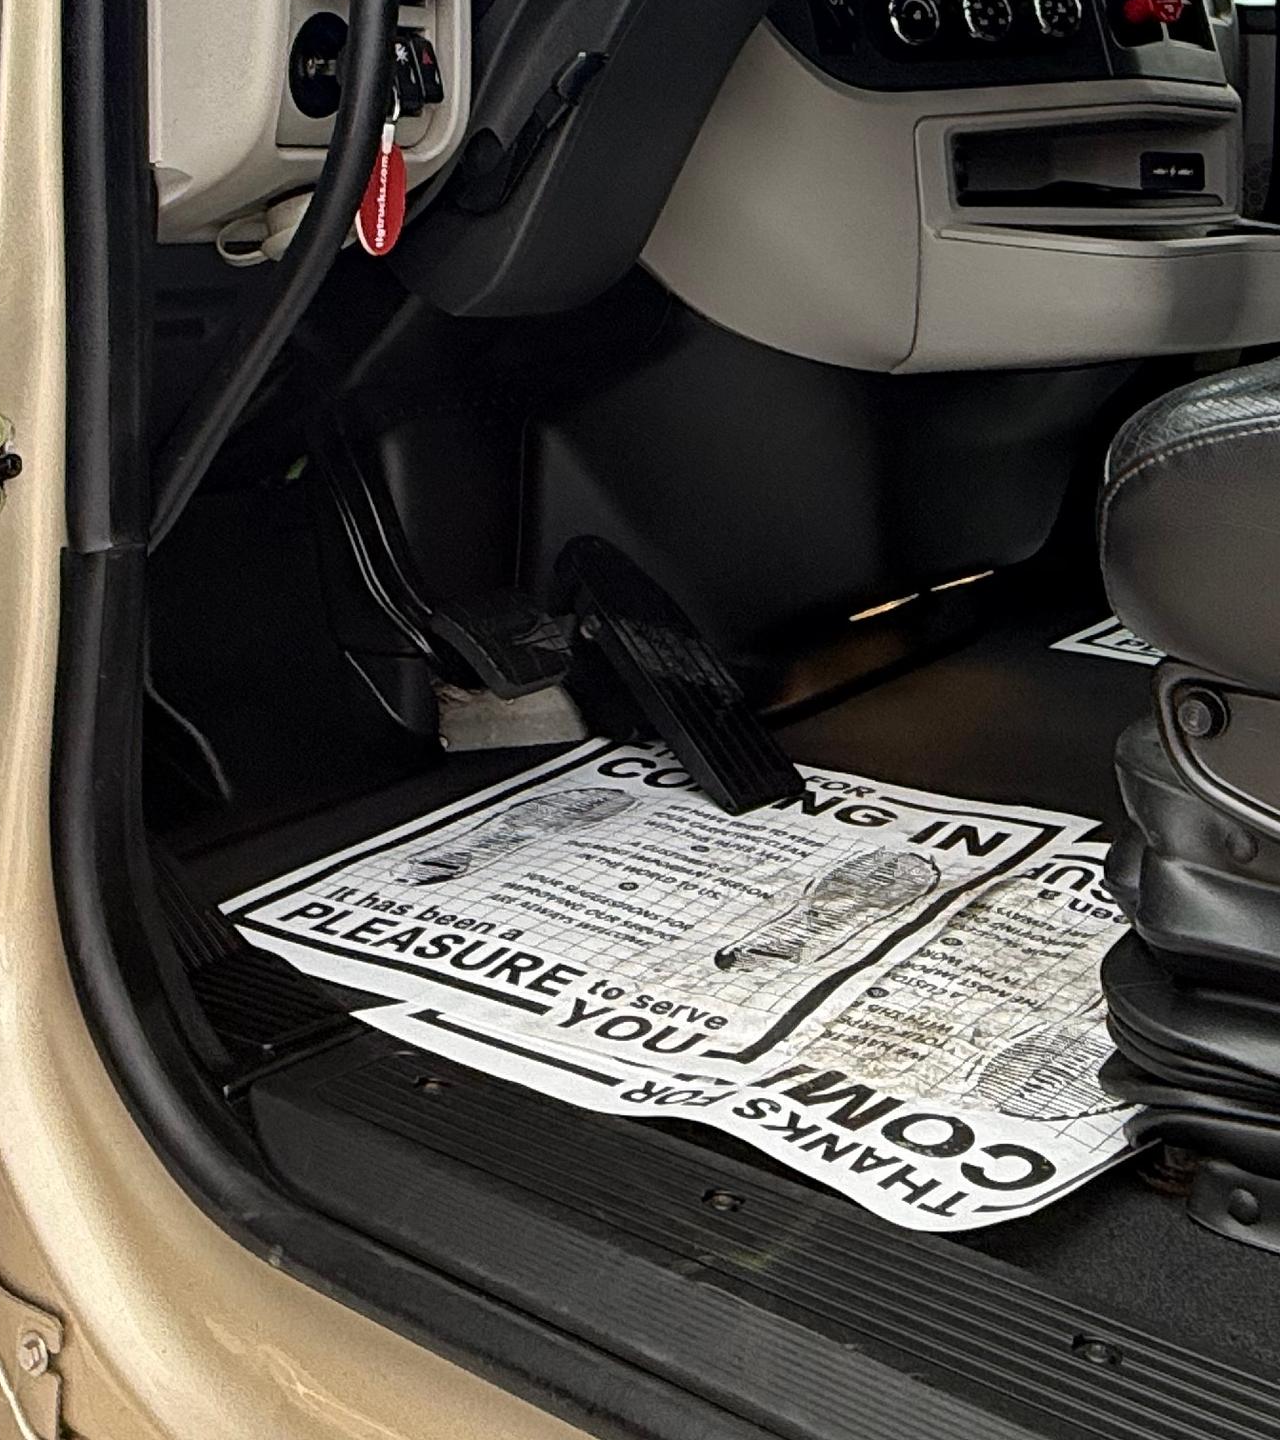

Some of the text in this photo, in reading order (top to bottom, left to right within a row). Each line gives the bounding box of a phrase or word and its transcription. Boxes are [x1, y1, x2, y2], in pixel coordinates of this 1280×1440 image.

[597, 757, 1012, 857] CONG IN
[808, 775, 877, 798] FOR
[325, 885, 523, 941] It has been a
[1068, 898, 1131, 924] een
[278, 901, 588, 998] PLEASURE
[560, 998, 711, 1055] YOU
[588, 977, 729, 1031] to serve
[620, 1080, 970, 1216] THANKS FOR
